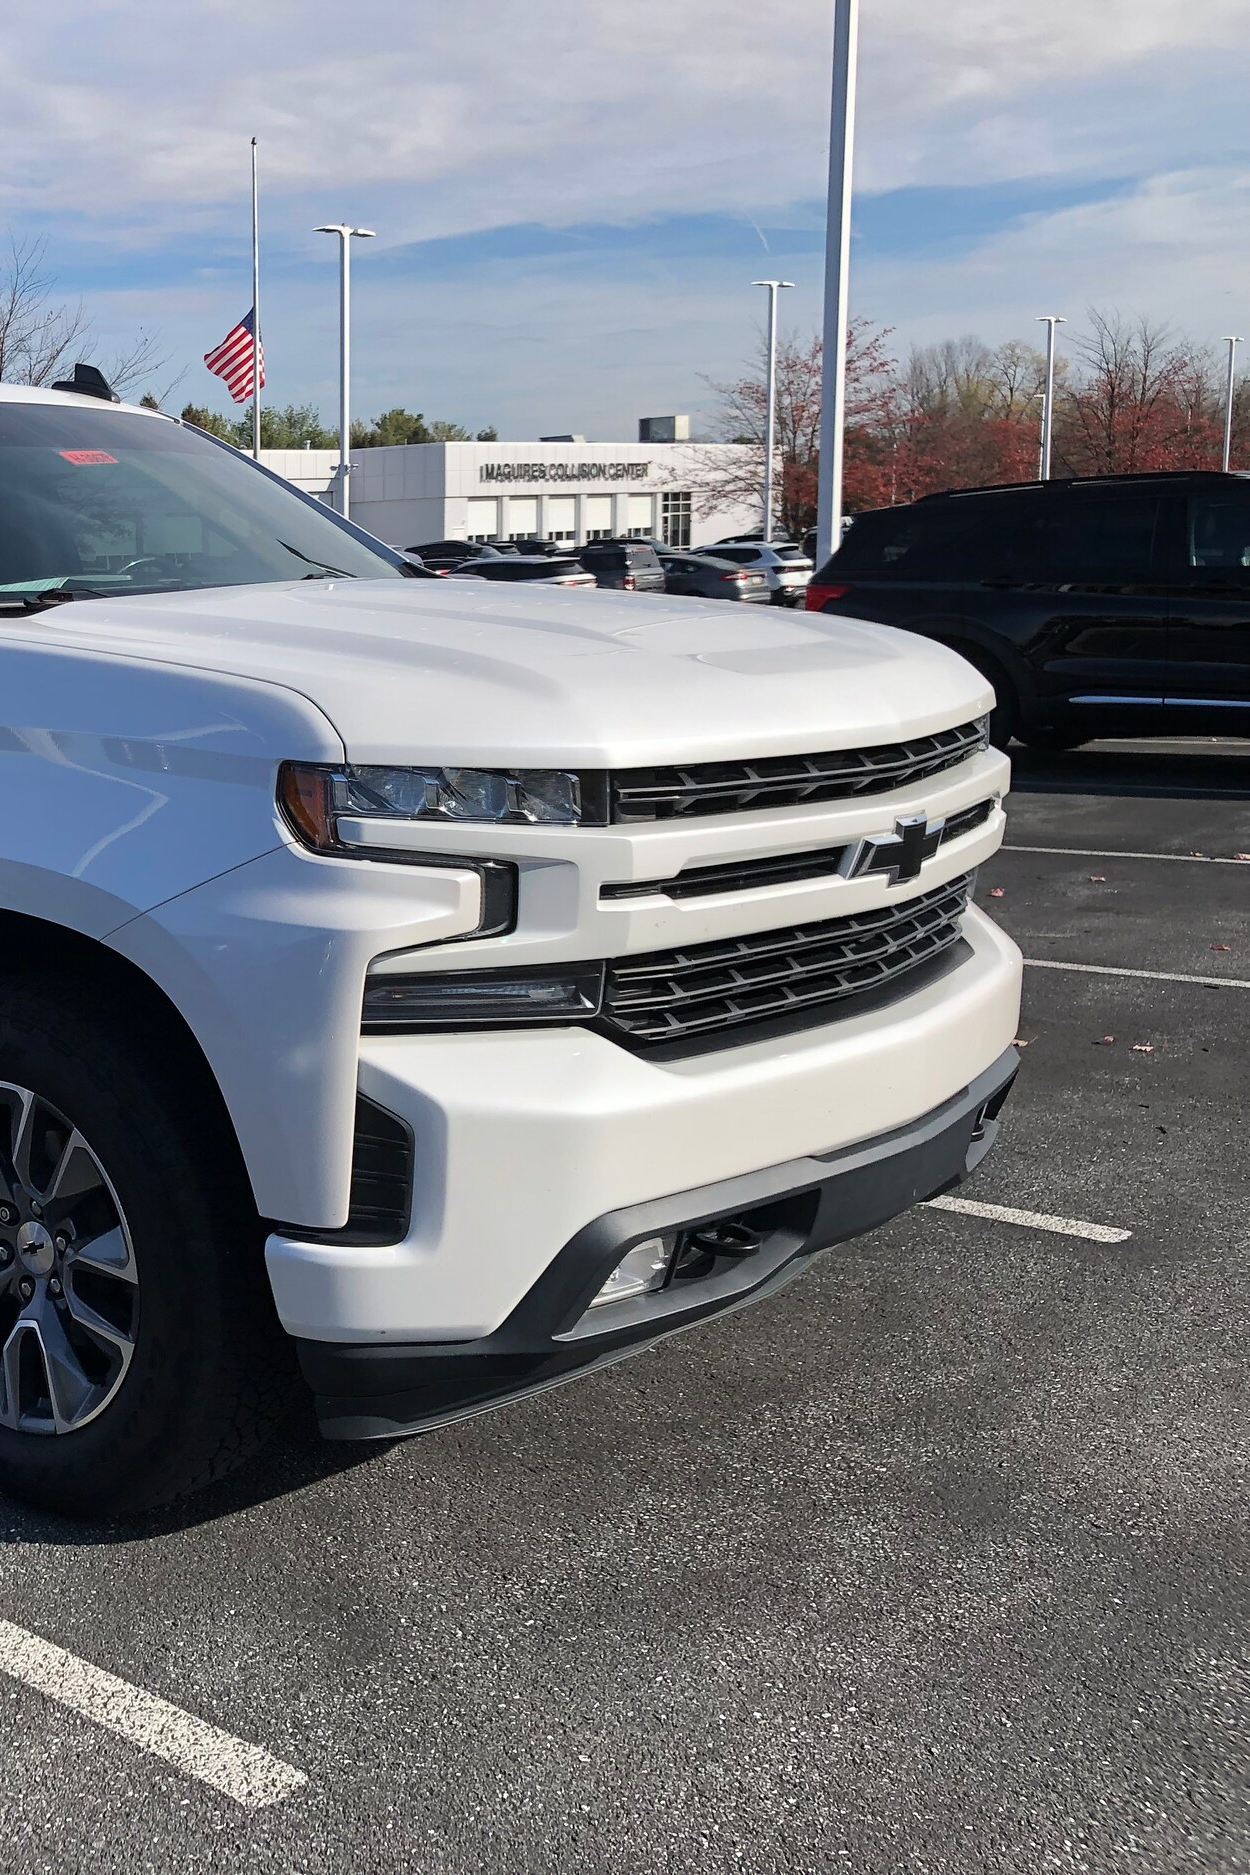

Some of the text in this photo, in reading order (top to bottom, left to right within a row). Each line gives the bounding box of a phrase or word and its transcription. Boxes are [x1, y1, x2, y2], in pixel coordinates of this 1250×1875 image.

[485, 462, 648, 480] MAGUIRES COLLISION CENTER
